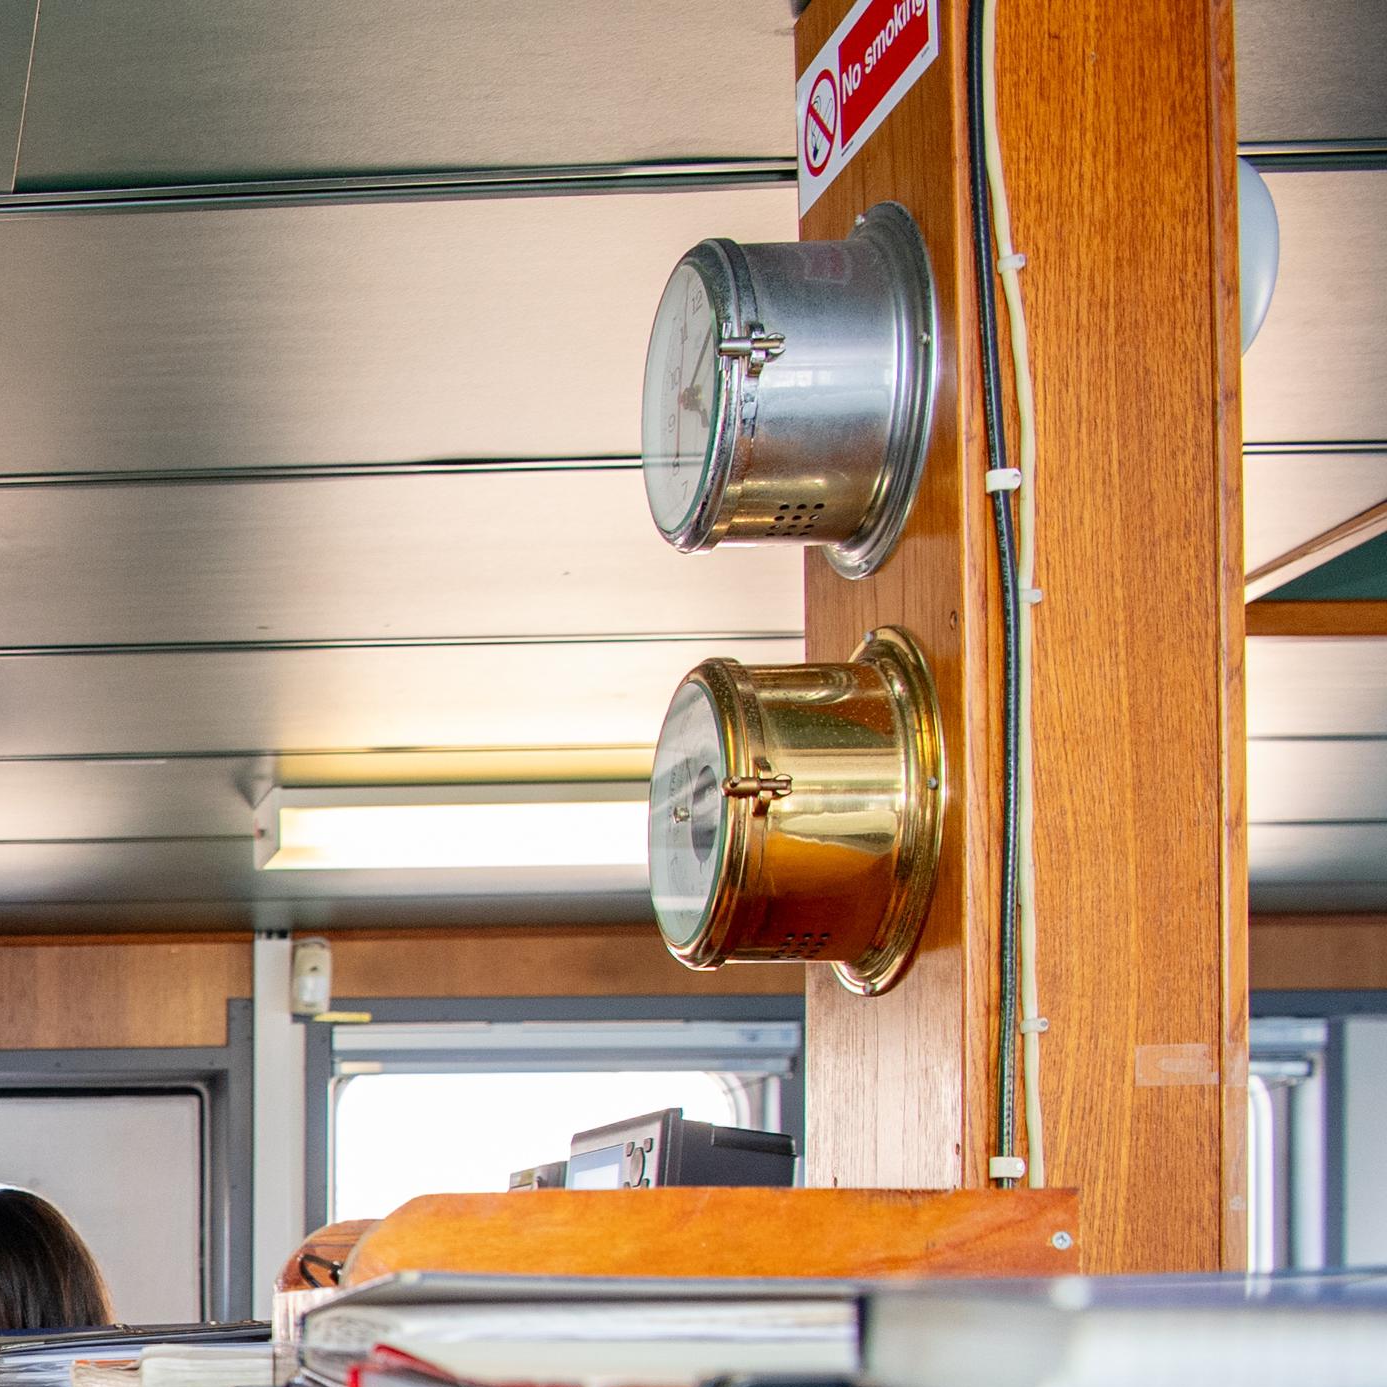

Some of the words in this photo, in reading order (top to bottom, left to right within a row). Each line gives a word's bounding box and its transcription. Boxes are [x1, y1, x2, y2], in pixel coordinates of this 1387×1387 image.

[842, 63, 862, 104] No
[864, 0, 926, 74] smoking
[691, 289, 703, 316] 12
[668, 414, 676, 433] 9
[682, 479, 688, 500] 7
